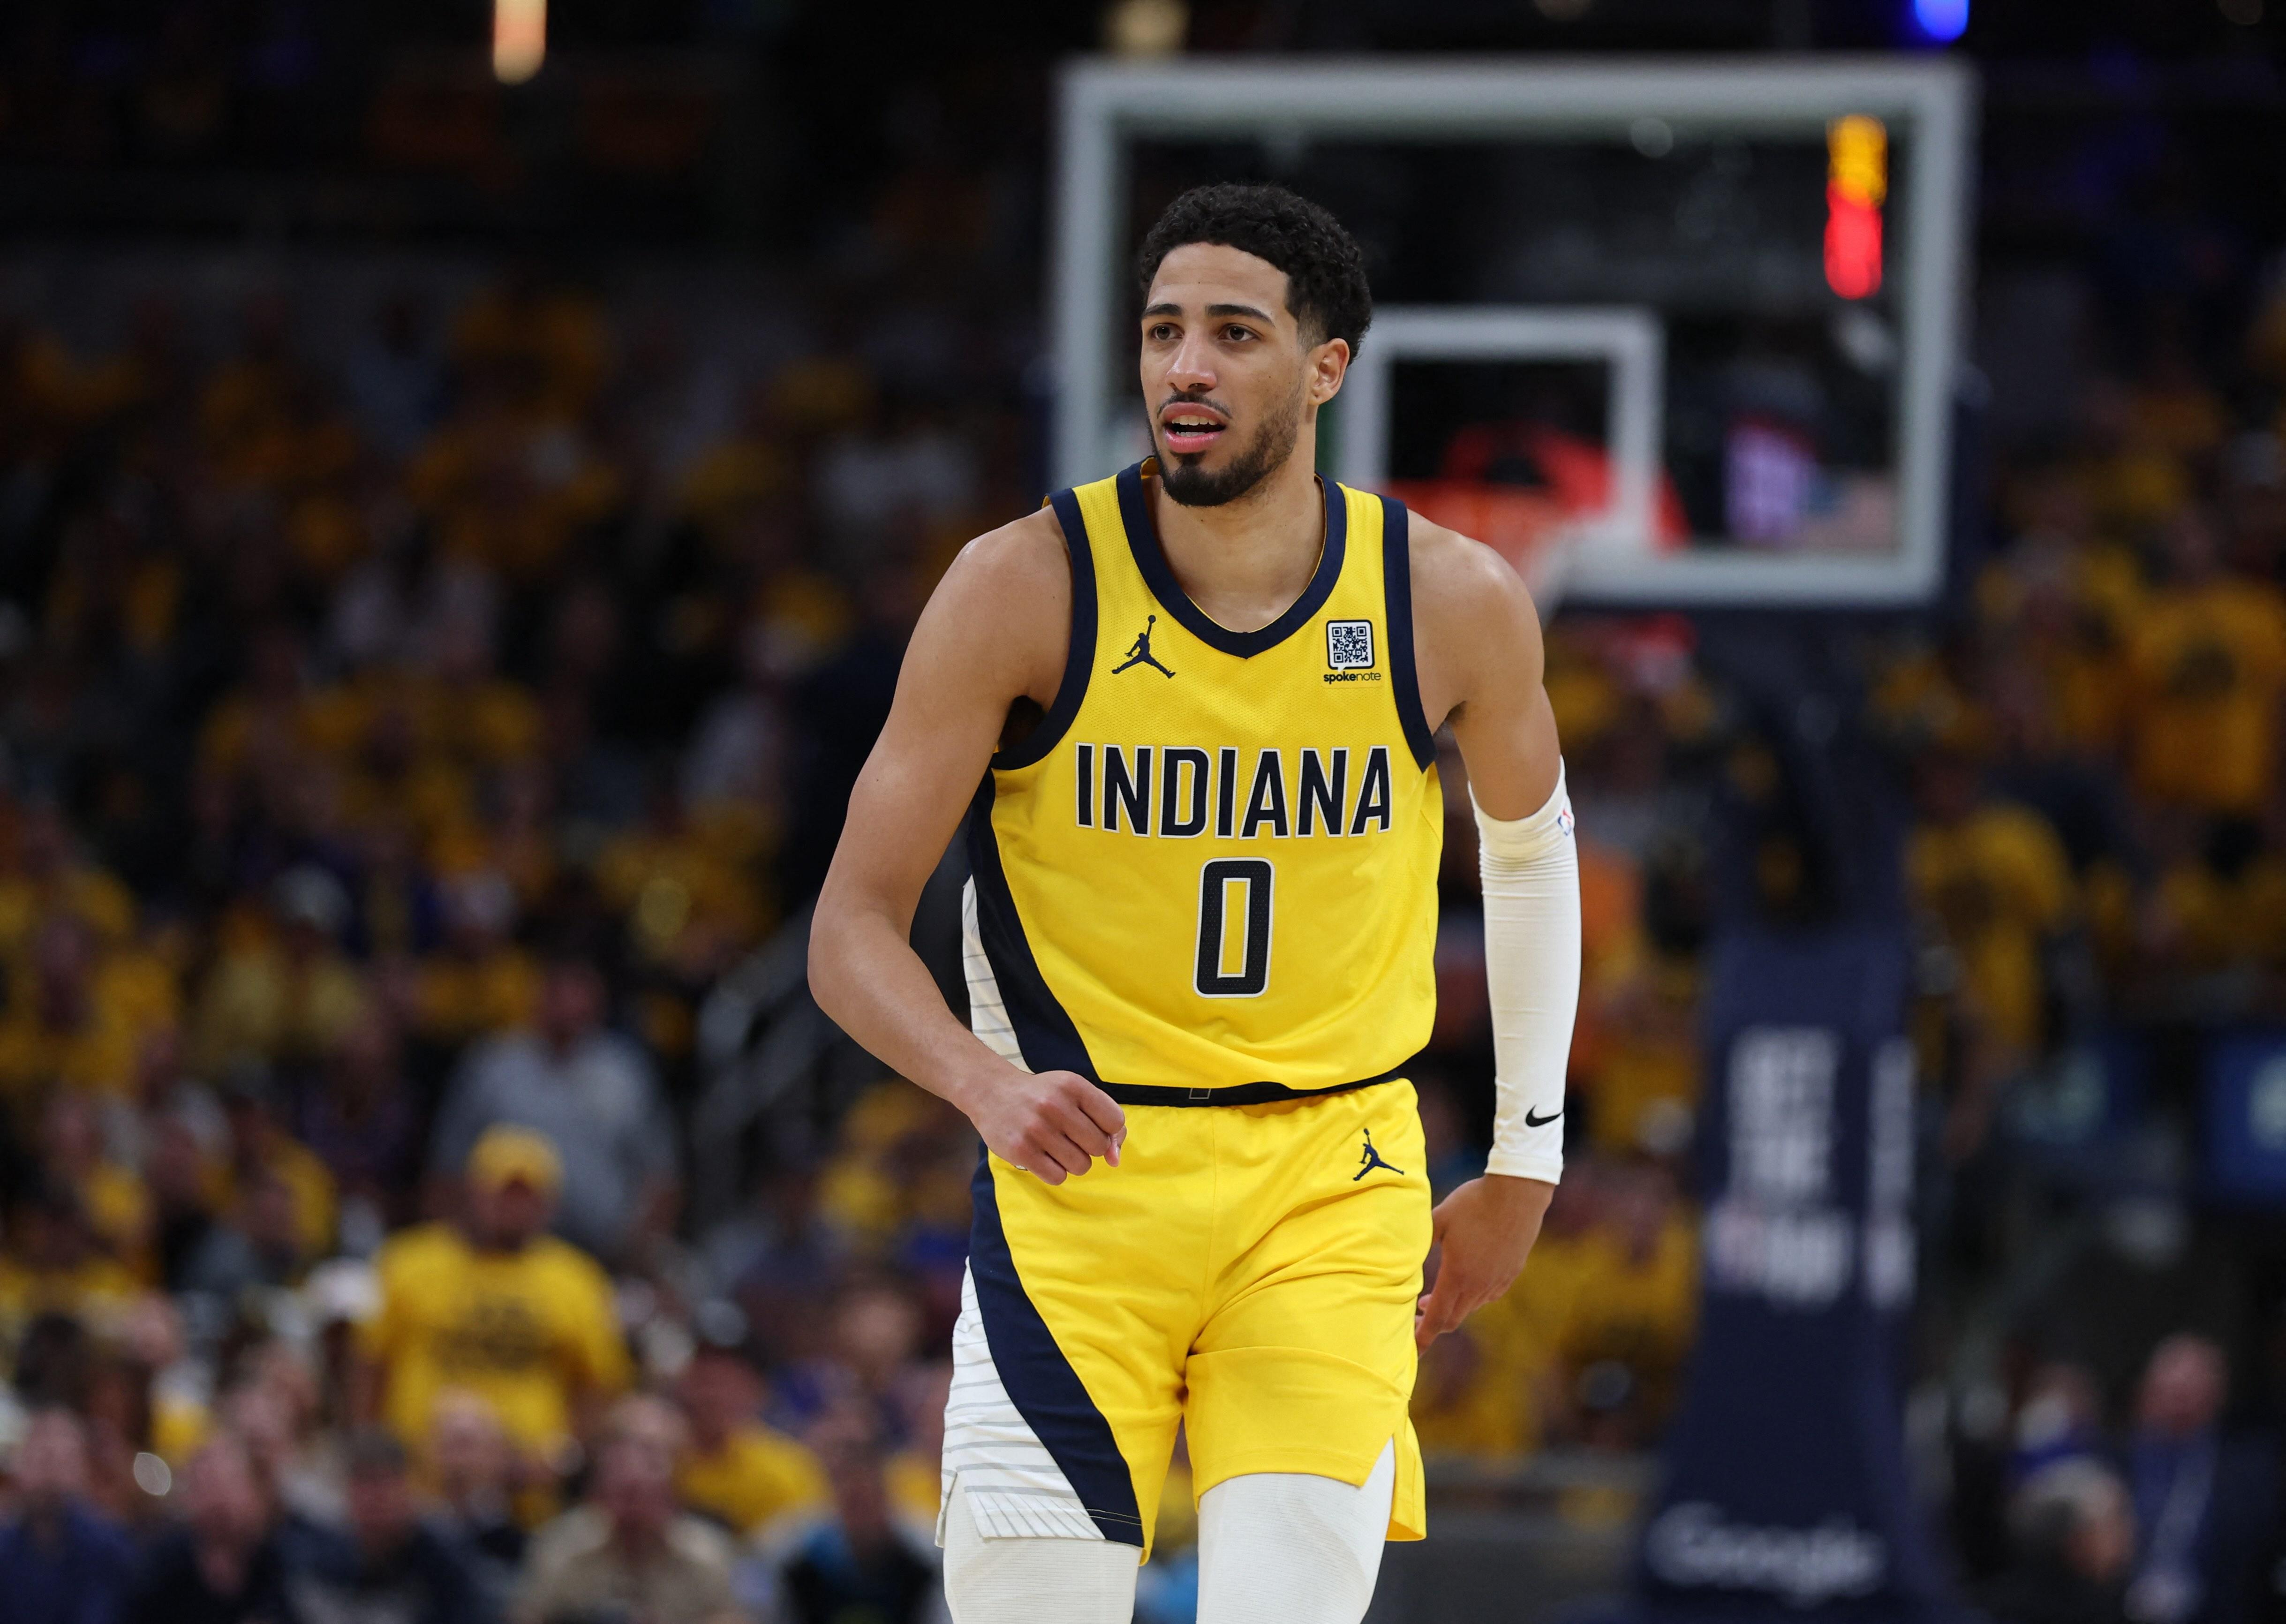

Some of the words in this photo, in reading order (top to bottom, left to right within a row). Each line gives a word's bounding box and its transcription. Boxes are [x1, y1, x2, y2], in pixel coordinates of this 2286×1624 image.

[1323, 671, 1381, 685] spokenote
[1075, 741, 1392, 840] INDIANA
[1192, 856, 1275, 999] 0
